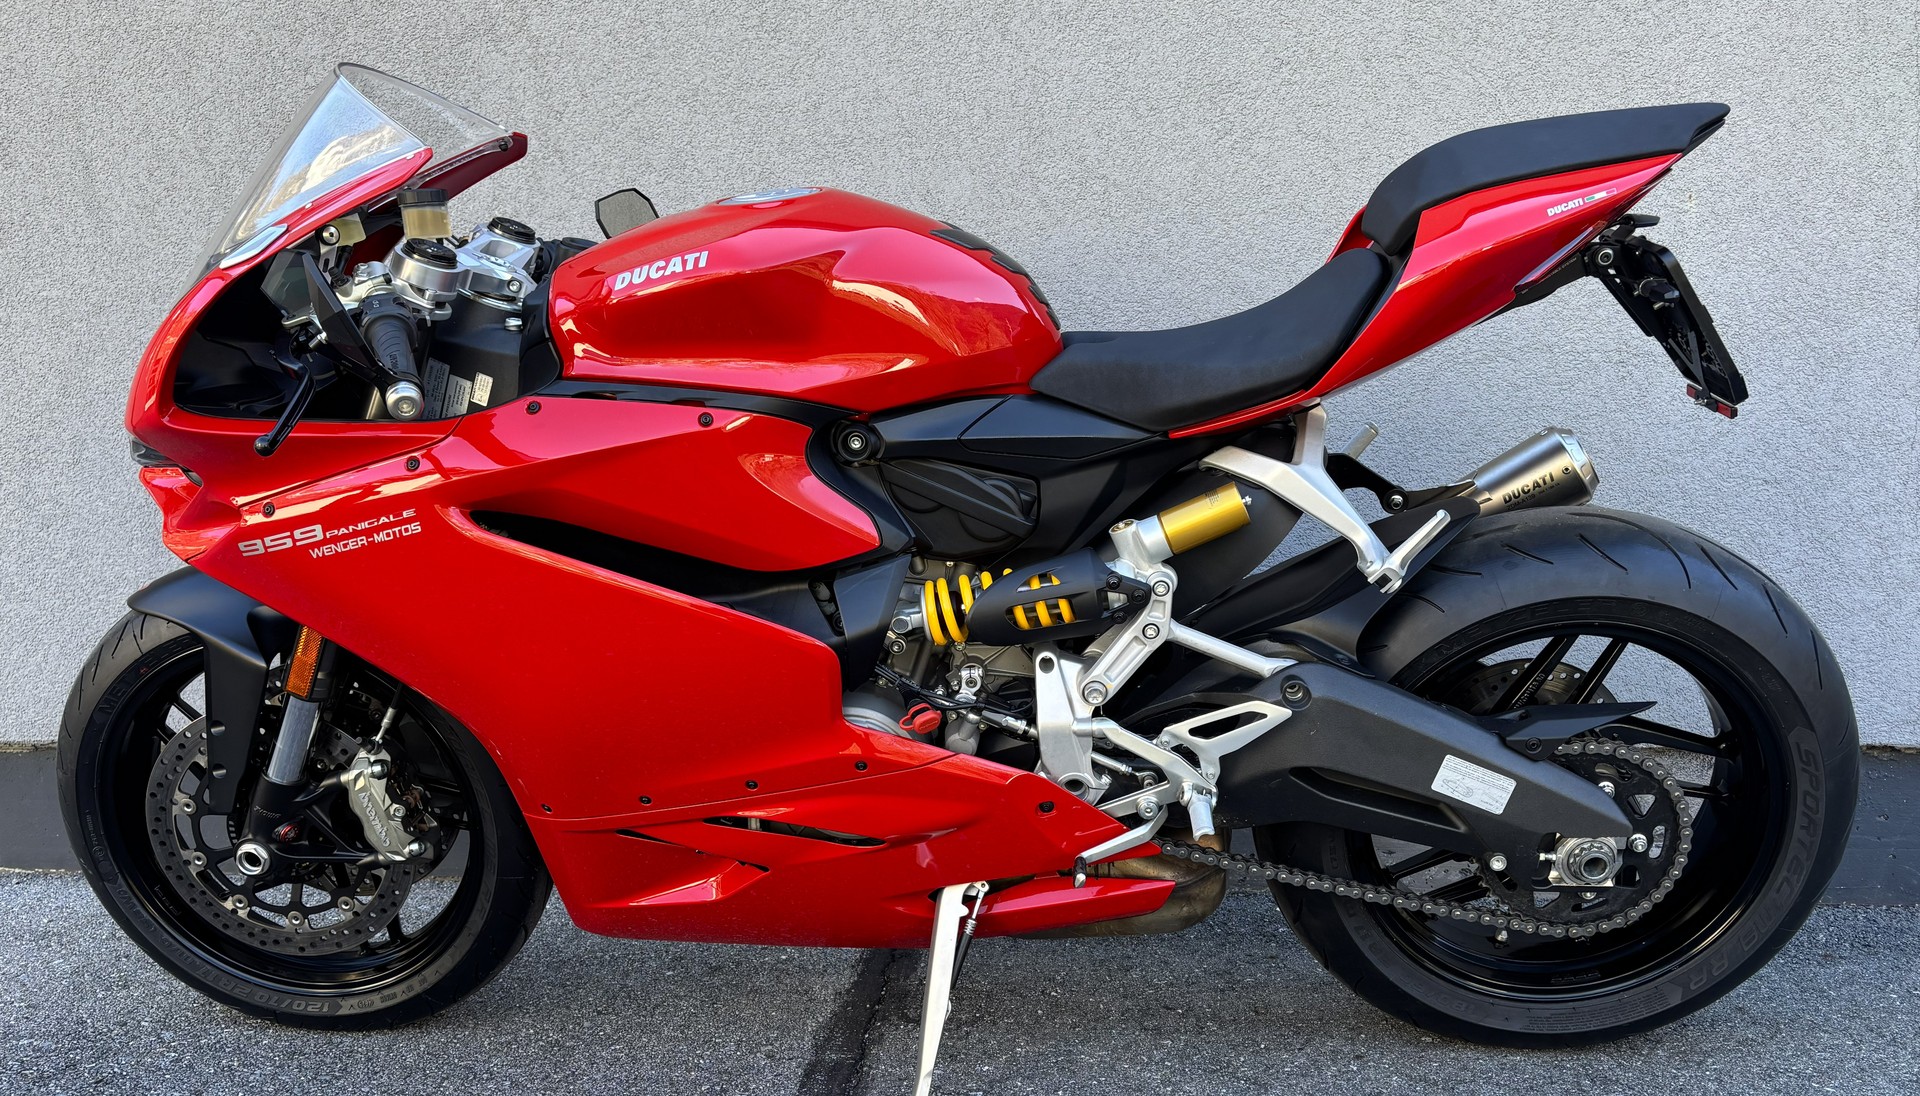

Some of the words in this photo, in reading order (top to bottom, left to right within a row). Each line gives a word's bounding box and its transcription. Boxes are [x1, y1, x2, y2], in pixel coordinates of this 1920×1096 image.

[1546, 197, 1584, 217] DUCATI
[614, 250, 709, 291] DUCATI
[1502, 472, 1555, 504] DUCATI
[238, 524, 324, 557] 959
[326, 508, 416, 539] PANIGALE
[309, 522, 422, 559] WENGER-MOTOS
[358, 790, 391, 847] brembo
[1775, 741, 1820, 903] SPORTEC
[253, 991, 330, 1013] 120/70
